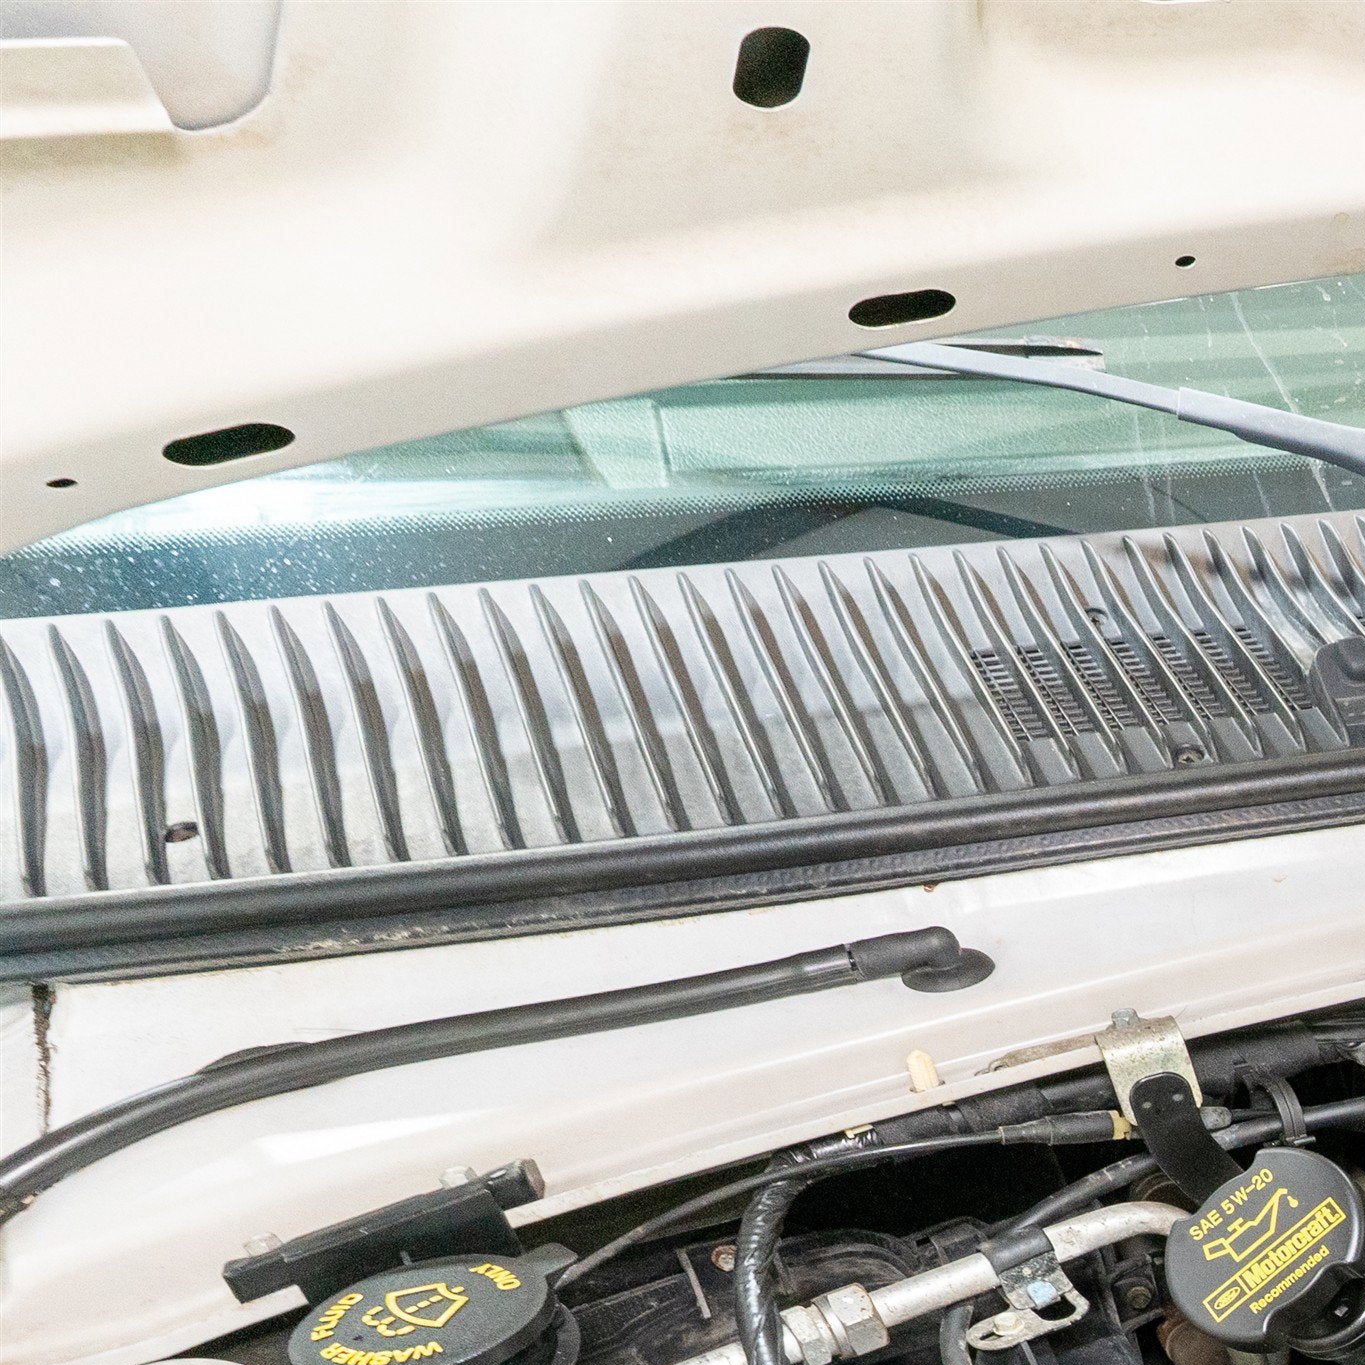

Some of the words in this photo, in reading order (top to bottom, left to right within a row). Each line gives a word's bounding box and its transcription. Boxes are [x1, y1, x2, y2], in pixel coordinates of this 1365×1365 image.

[1189, 1210, 1223, 1241] SAE
[310, 1293, 363, 1341] FLUID
[468, 1263, 521, 1290] ONLY
[1249, 1245, 1331, 1315] Recommended
